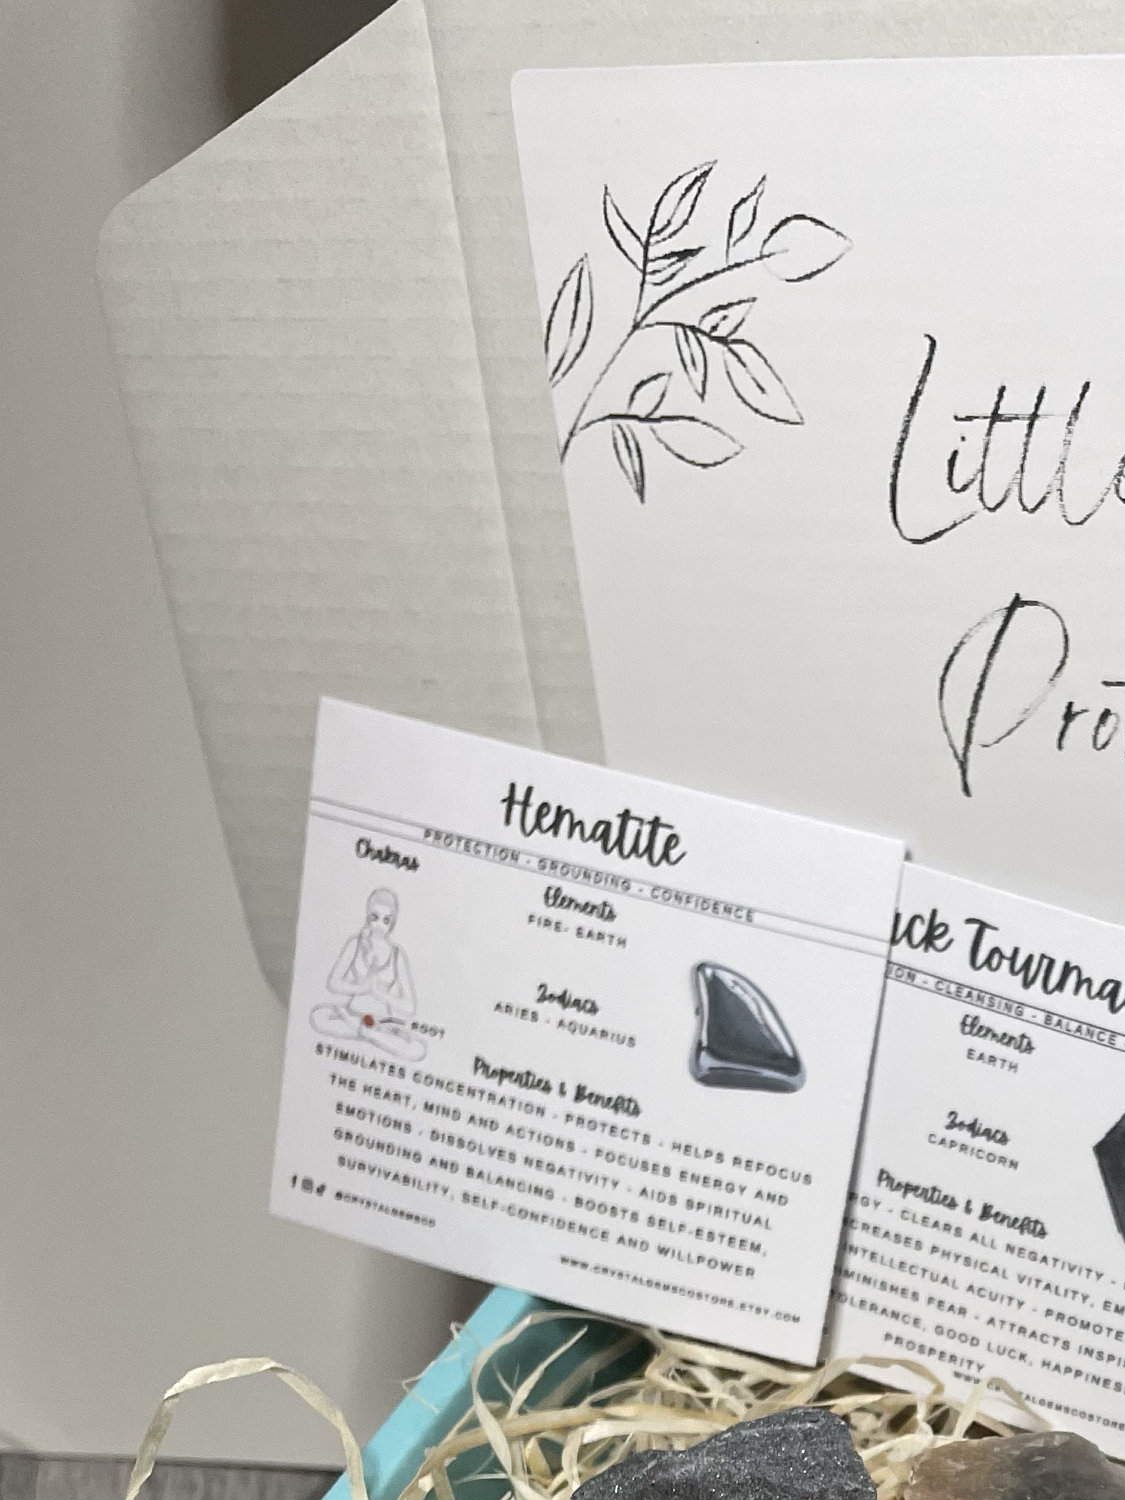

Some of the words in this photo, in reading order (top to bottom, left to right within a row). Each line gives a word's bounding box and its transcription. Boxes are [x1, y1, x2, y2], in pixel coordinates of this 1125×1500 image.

[501, 782, 687, 867] Hematite
[544, 886, 617, 922] Elements
[557, 1018, 636, 1048] AQUARIUS
[931, 983, 1024, 1020] CLEANSING
[1042, 1014, 1118, 1047] BALANCE
[960, 1014, 1035, 1054] Elements
[473, 1056, 552, 1094] Properties
[574, 1084, 641, 1118] Benefits
[966, 1049, 1018, 1073] EARTH
[314, 1042, 407, 1079] STIMULATES
[411, 1070, 547, 1118] CONCENTRATION
[563, 1111, 652, 1146] PROTECTS
[670, 1139, 725, 1164] HELPS
[731, 1155, 813, 1186] REFOCUS
[328, 1072, 358, 1092] THE
[422, 1099, 461, 1121] MIND
[466, 1112, 500, 1132] AND
[504, 1123, 576, 1153] ACTIONS
[593, 1146, 672, 1178] FOCUSES
[678, 1167, 747, 1196] ENERGY
[753, 1188, 789, 1207] AND
[333, 1126, 423, 1163] GROUNDING
[427, 1154, 461, 1174] AND
[464, 1165, 555, 1202] BALANCING
[572, 1195, 640, 1224] BOOSTS
[335, 1101, 413, 1134] EMOTIONS
[429, 1128, 518, 1164] DISSOLVES
[522, 1154, 620, 1191] NEGATIVITY
[637, 1185, 678, 1207] AIDS
[684, 1196, 772, 1231] SPIRITUAL
[928, 1133, 1018, 1170] CAPRICORN
[877, 1167, 958, 1210] Properties
[979, 1203, 1047, 1239] Benefits
[616, 1233, 650, 1252] AND
[655, 1242, 756, 1280] WILLPOWER
[900, 1207, 963, 1238] CLEARS
[969, 1232, 997, 1250] ALL
[1004, 1243, 1104, 1282] NEGATIVITY
[930, 1244, 1008, 1280] PHYSICAL
[926, 1294, 968, 1318] FEAR
[986, 1316, 1071, 1351] ATTRACTS
[966, 1284, 1026, 1310] ACUITY
[883, 1333, 985, 1373] PROSPERITY
[933, 1323, 980, 1347] GOOD
